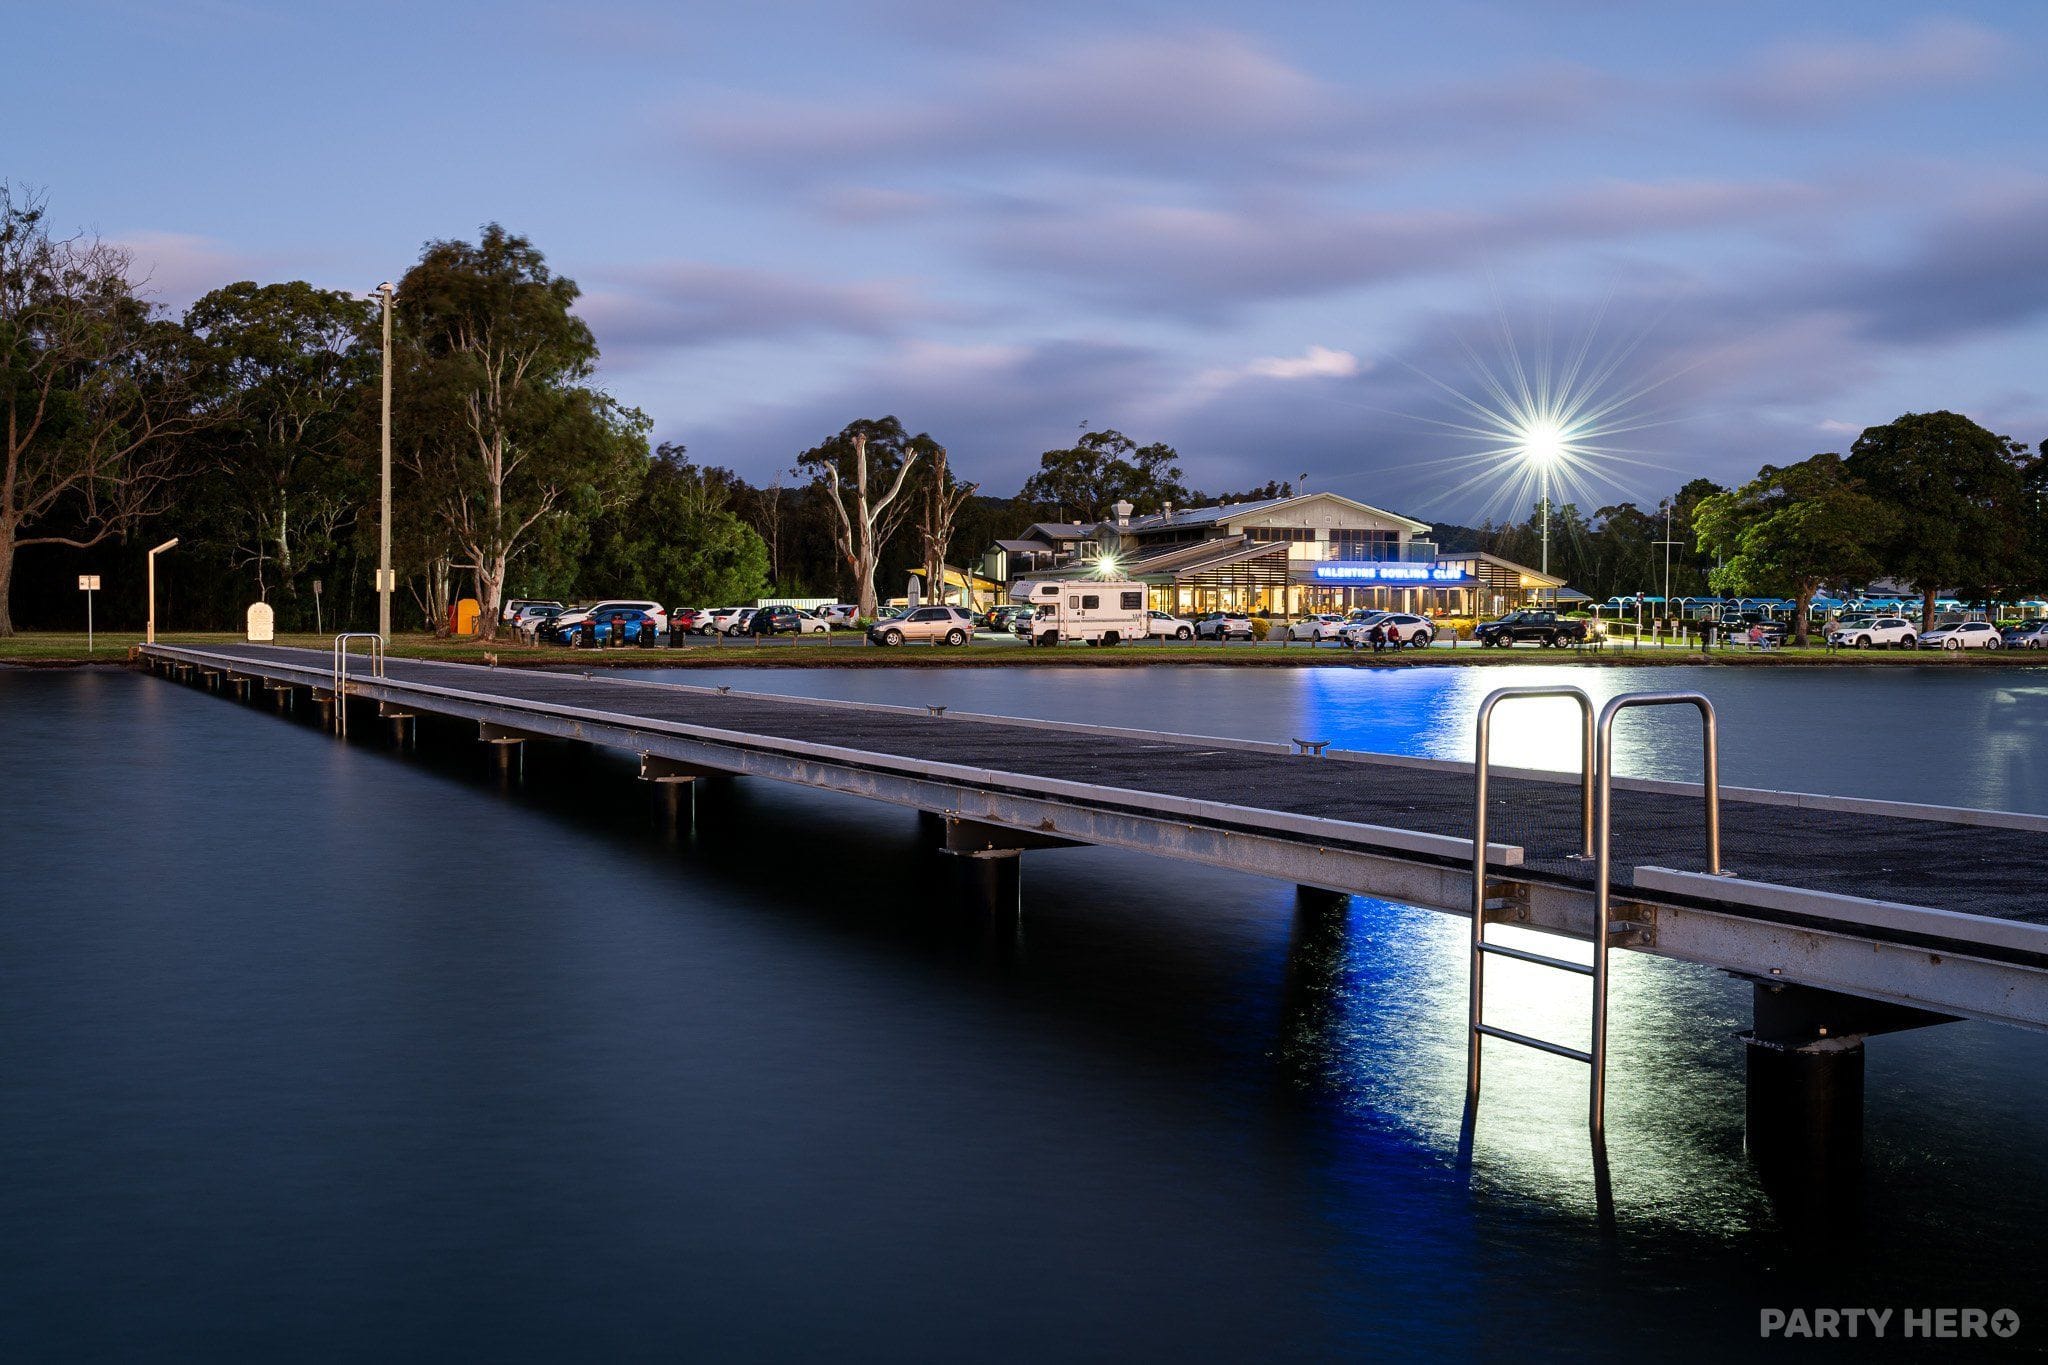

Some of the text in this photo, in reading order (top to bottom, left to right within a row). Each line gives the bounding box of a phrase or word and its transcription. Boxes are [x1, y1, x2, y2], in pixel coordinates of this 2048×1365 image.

[1317, 567, 1461, 580] VALENTINE BOWLING CLUB
